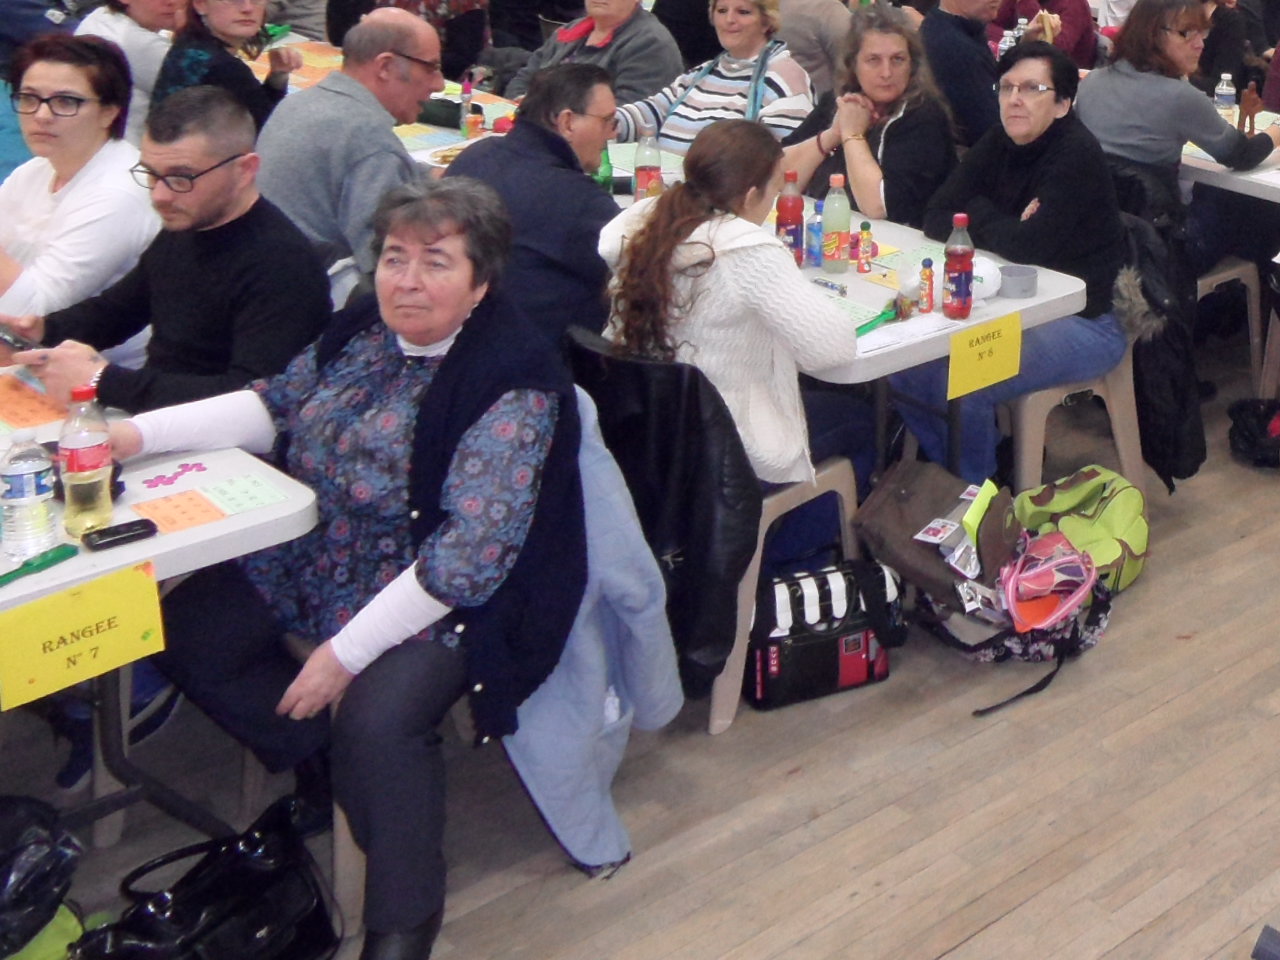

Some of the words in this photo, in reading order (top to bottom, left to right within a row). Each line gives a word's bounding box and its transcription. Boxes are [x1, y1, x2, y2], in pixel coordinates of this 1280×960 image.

[968, 330, 1002, 348] RANGEE
[41, 615, 119, 655] RANGEE
[90, 646, 100, 659] 7
